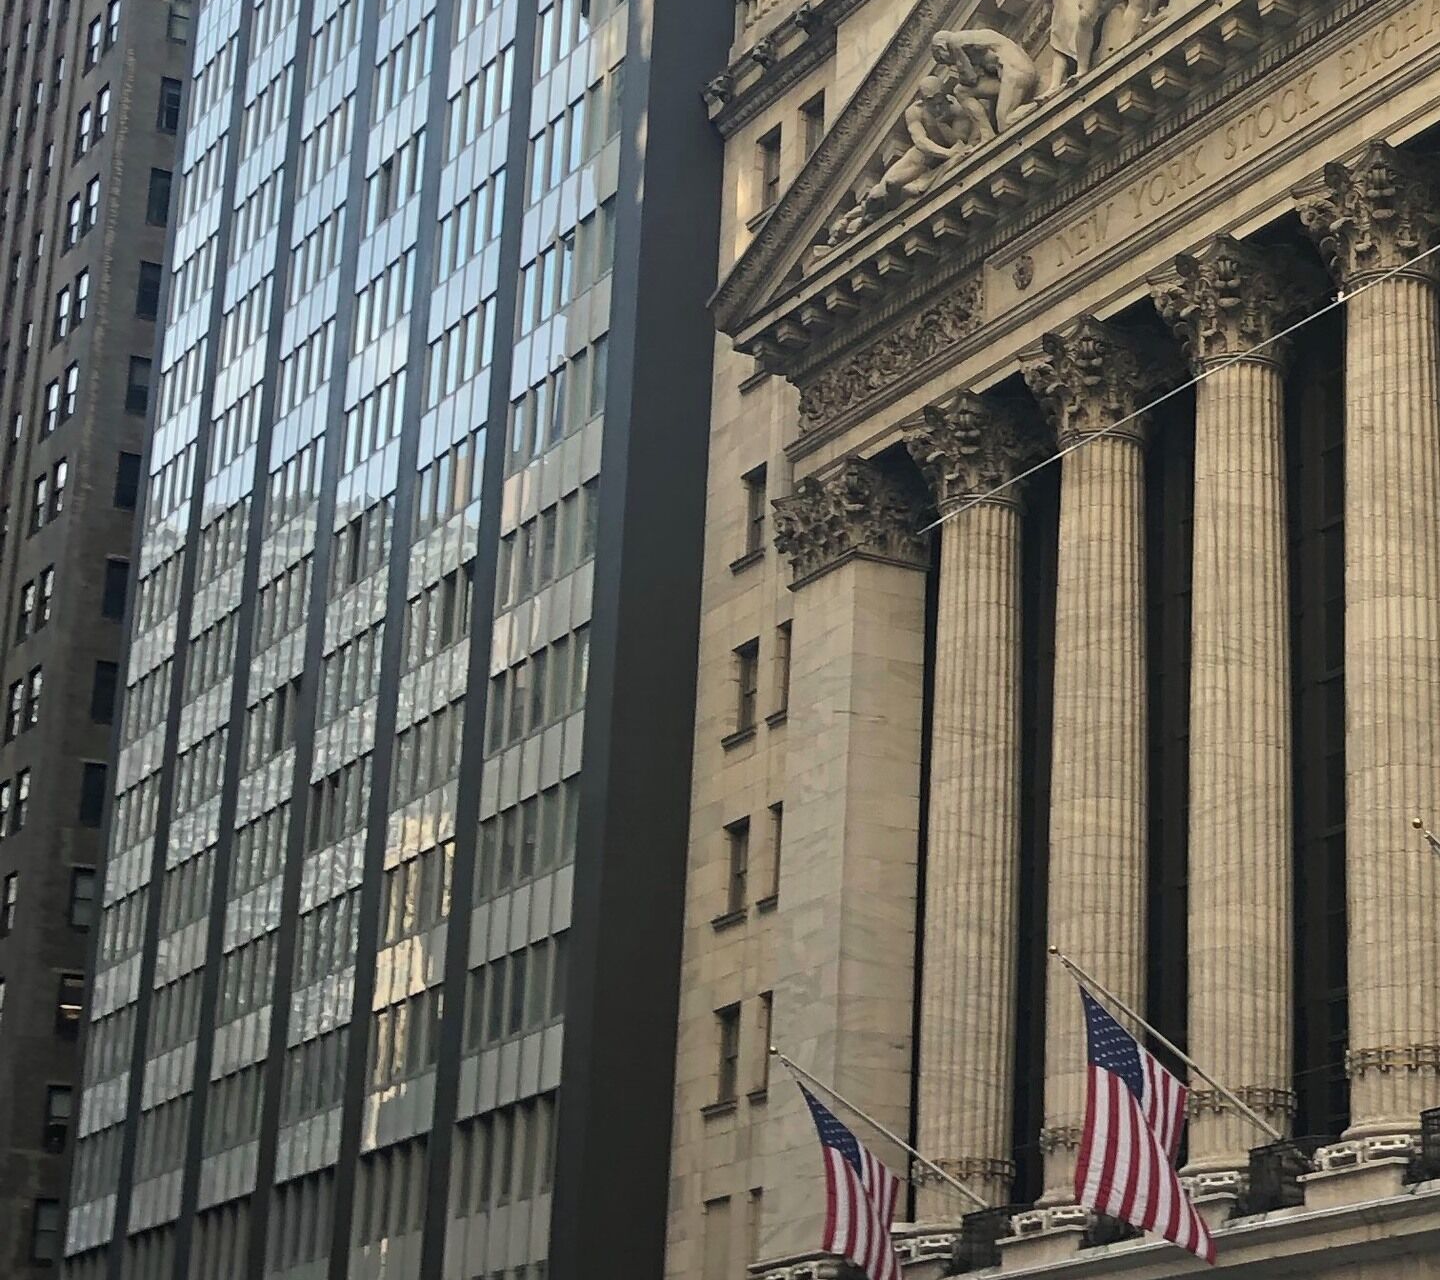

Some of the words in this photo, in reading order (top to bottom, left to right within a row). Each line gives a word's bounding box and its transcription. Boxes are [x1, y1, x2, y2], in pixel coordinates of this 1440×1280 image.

[1055, 202, 1114, 267] NEW
[1128, 144, 1206, 218] YORK
[1223, 70, 1320, 160] STOCK
